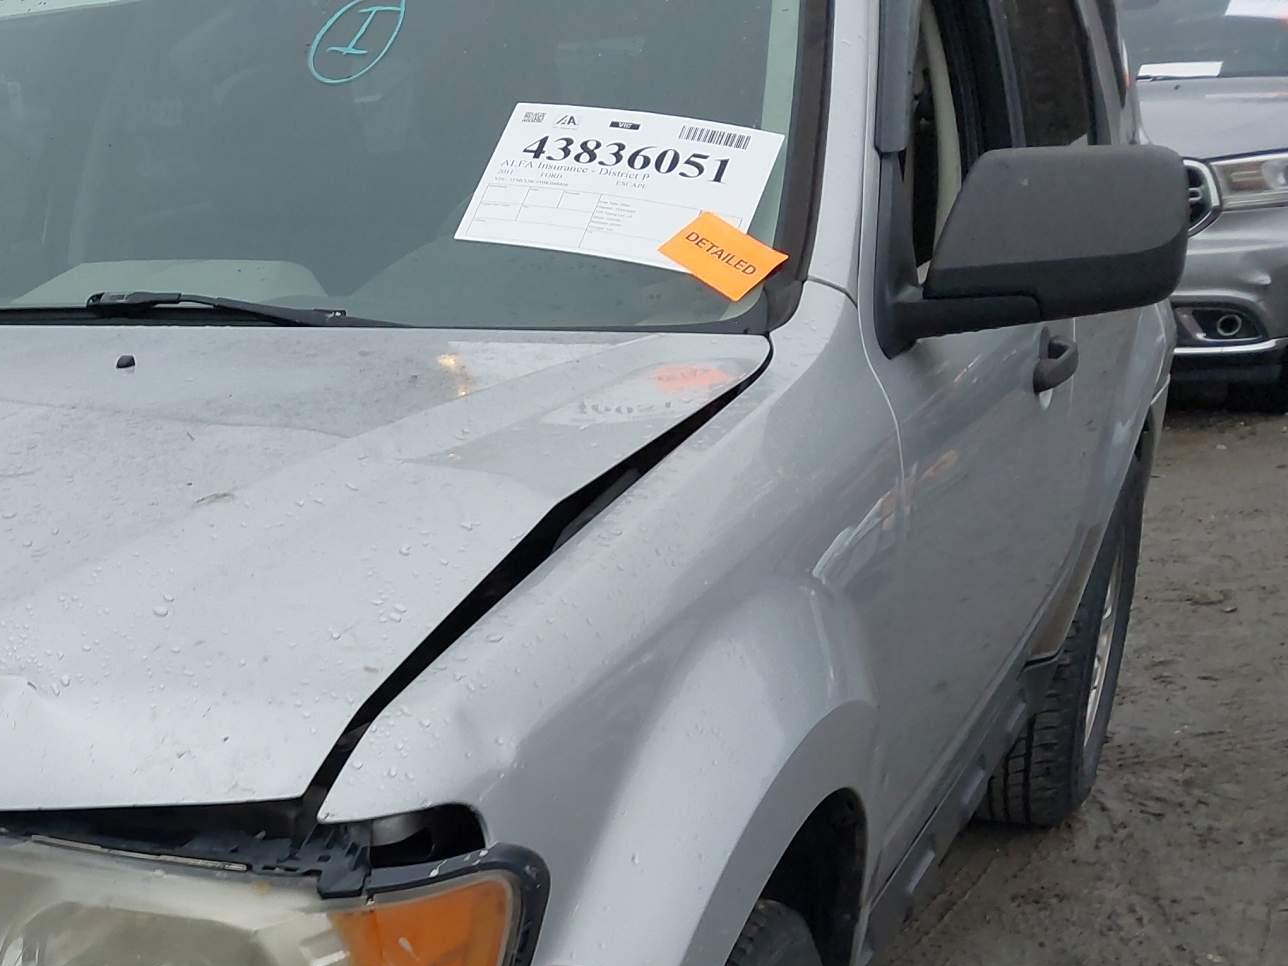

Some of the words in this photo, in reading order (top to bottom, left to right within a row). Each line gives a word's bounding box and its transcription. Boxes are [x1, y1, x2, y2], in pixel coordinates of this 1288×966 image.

[522, 135, 730, 184] 43836051
[537, 159, 589, 174] Insurance
[599, 167, 639, 181] District
[685, 231, 757, 275] DETAILED
